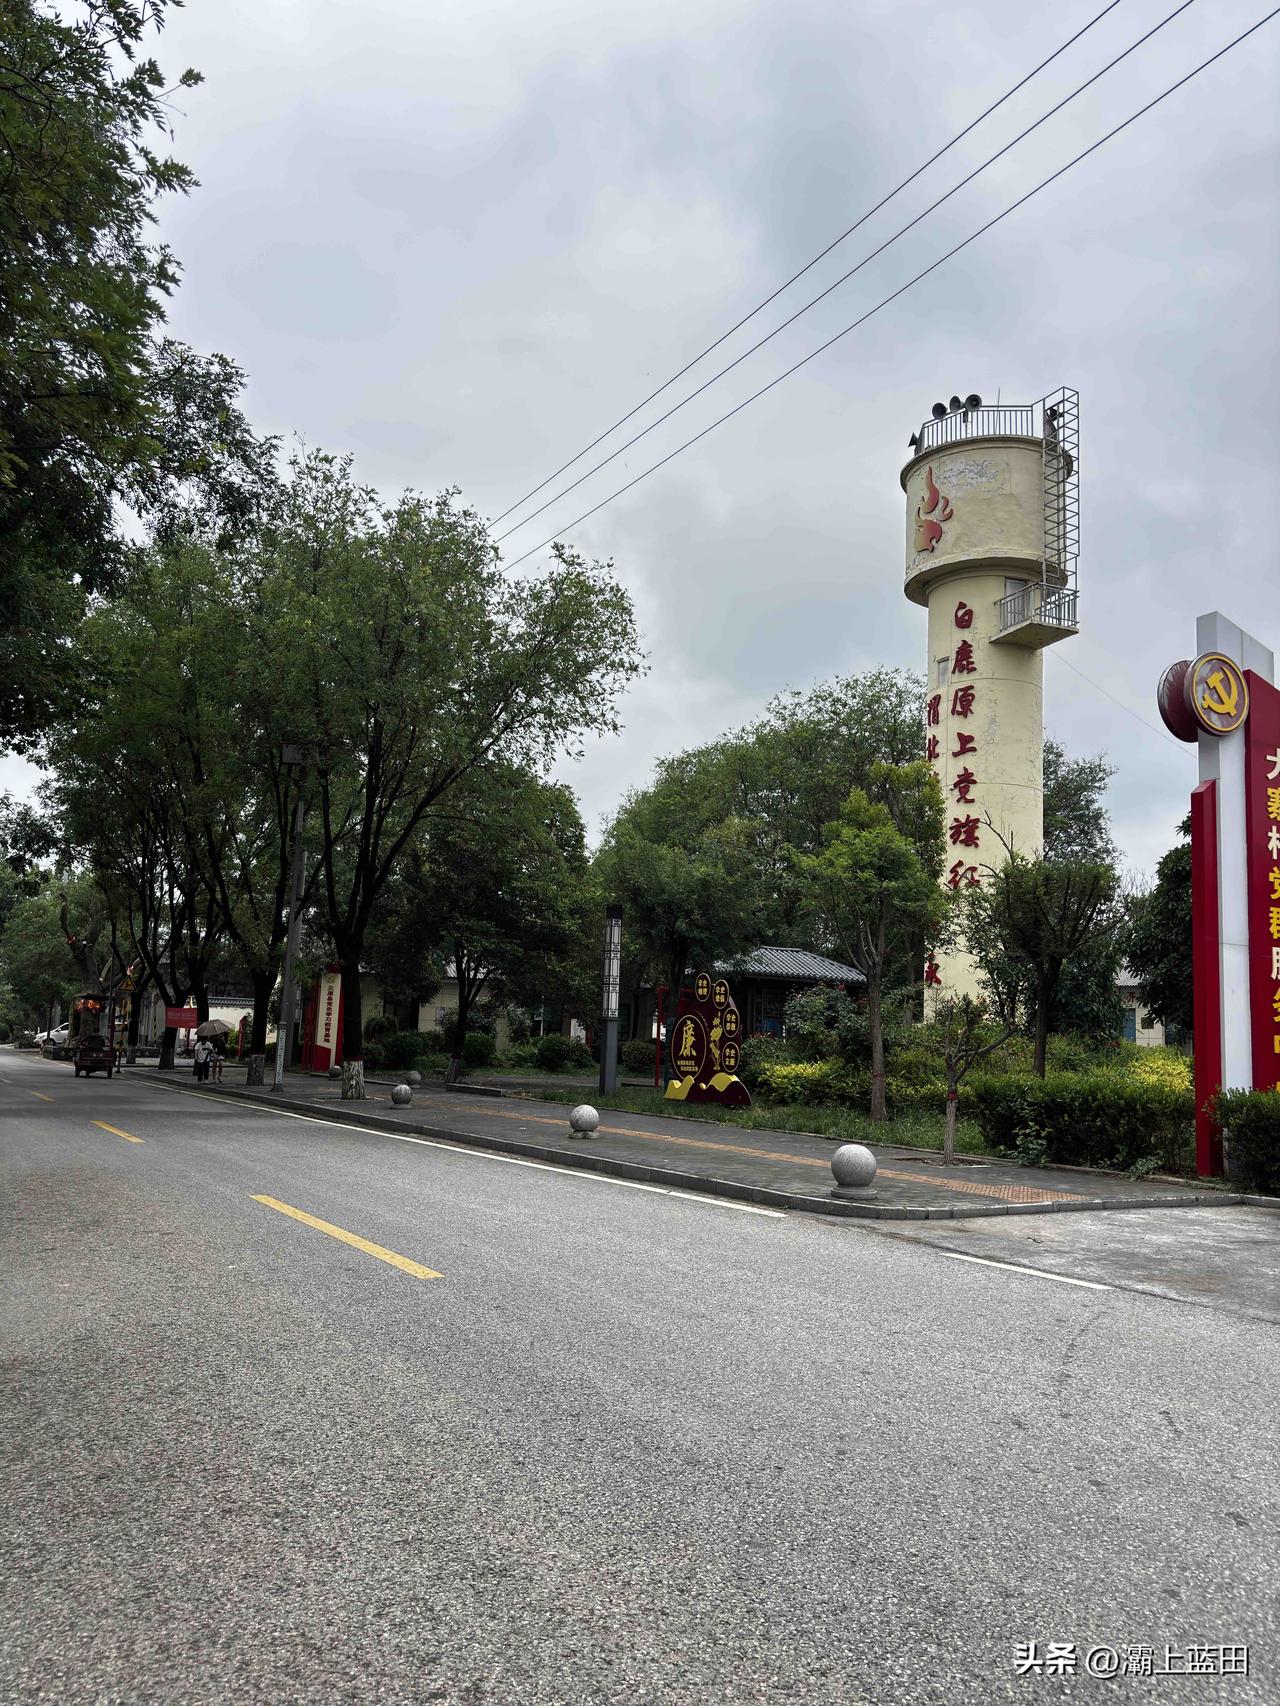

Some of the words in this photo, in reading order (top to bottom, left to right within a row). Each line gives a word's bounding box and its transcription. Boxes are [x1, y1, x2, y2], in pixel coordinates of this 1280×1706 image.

[948, 601, 981, 889] 白鹿原上党旗红
